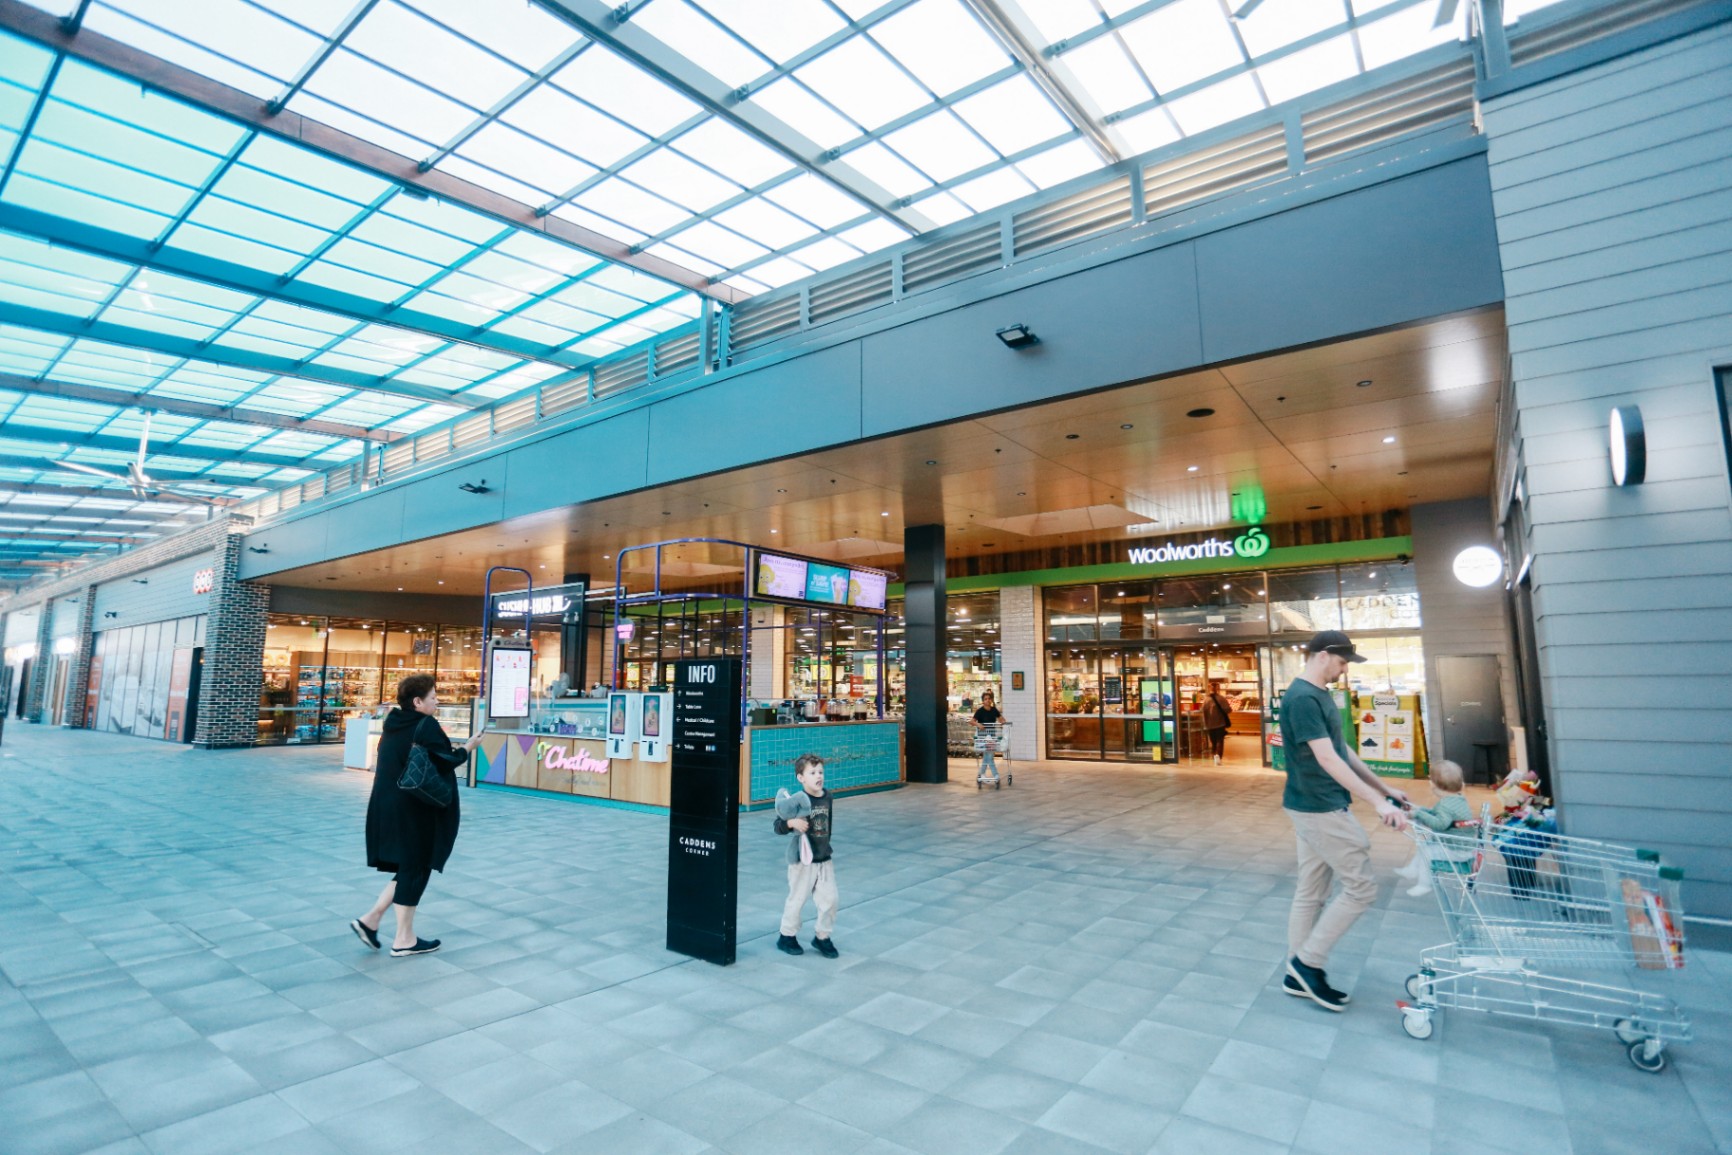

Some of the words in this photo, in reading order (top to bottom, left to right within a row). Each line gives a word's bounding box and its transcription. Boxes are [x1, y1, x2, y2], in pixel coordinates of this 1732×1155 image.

[1128, 538, 1234, 565] Woolworths
[688, 665, 715, 684] INFO
[544, 745, 609, 774] Chatime
[679, 836, 716, 850] CADDENS
[685, 847, 710, 856] CORNER
